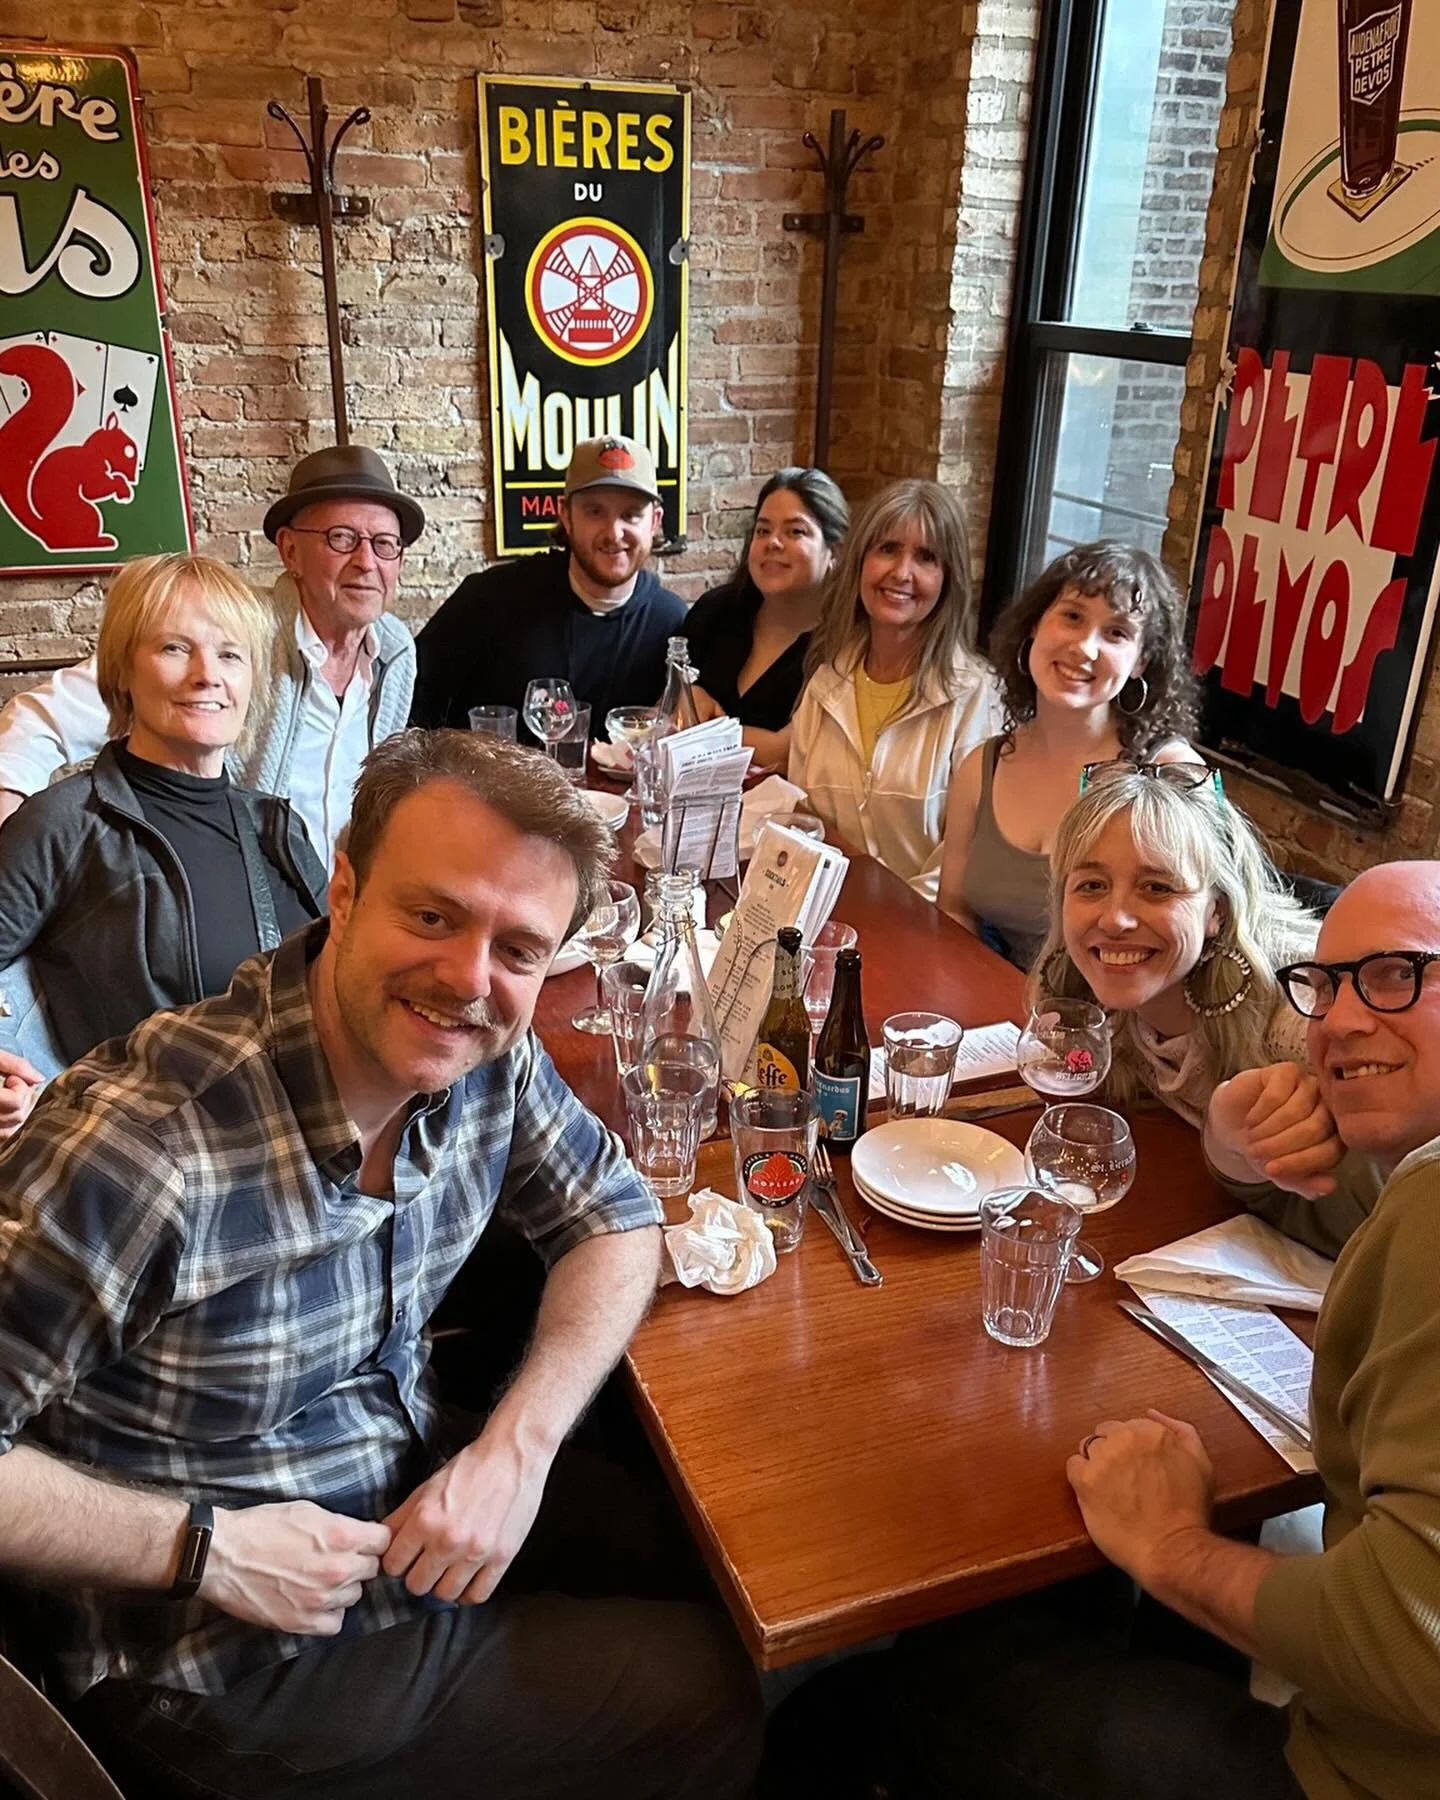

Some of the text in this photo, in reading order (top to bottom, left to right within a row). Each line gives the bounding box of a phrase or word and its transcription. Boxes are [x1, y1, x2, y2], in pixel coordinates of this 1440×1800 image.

[1355, 41, 1392, 74] PETRE
[1354, 63, 1390, 94] DEVOS
[499, 100, 674, 173] BIÈRES
[0, 150, 60, 180] es
[574, 183, 602, 202] DU
[500, 328, 678, 471] MOULIN
[1216, 346, 1439, 557] PETRE
[521, 496, 564, 516] MA
[1191, 525, 1408, 735] DEVOS
[752, 1178, 800, 1188] HOPLEAF
